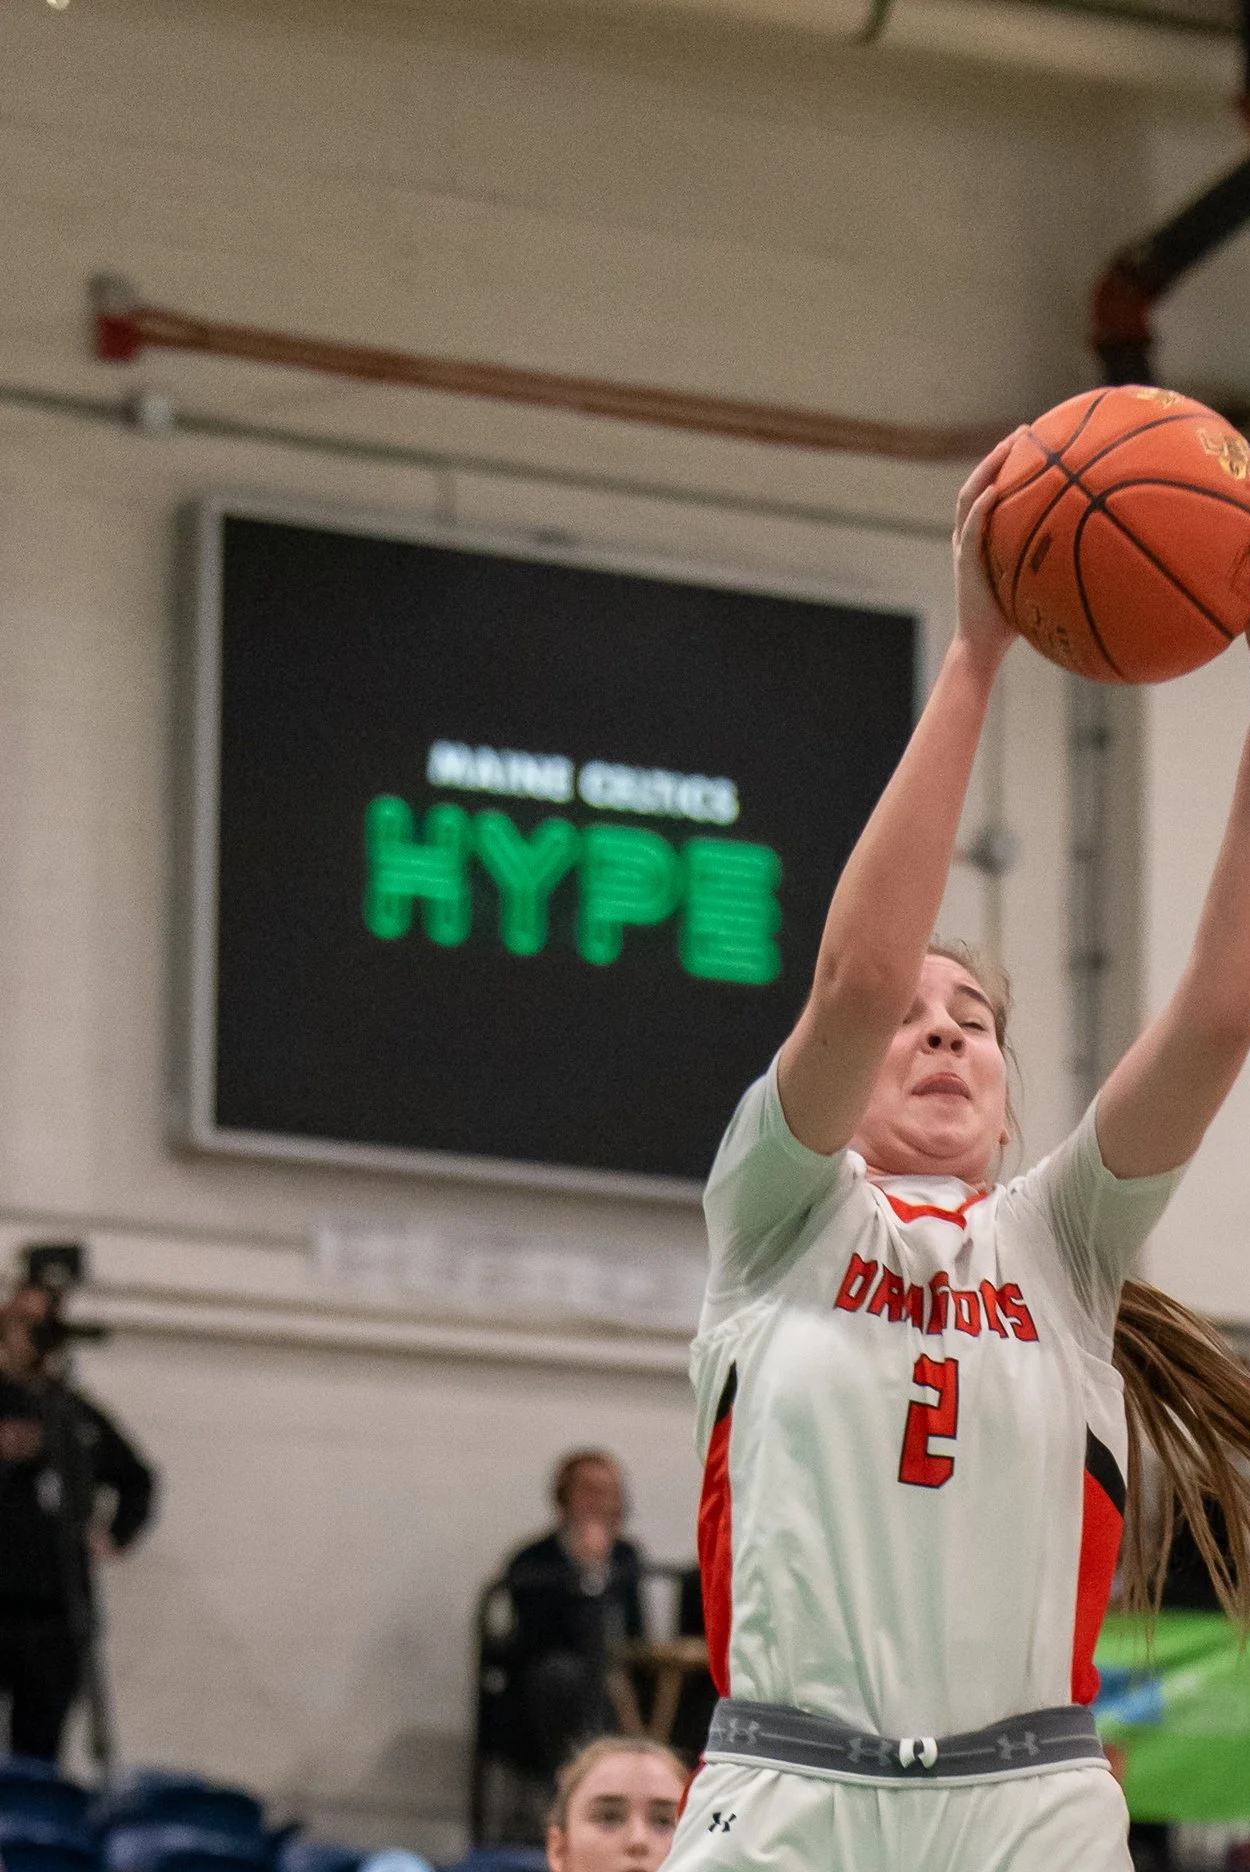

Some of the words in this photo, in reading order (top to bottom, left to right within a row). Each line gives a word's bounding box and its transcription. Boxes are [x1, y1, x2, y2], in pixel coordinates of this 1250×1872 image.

[427, 740, 575, 803] MAINE
[578, 760, 741, 826] CELTICS
[363, 793, 784, 986] HYPE
[897, 1353, 959, 1489] 2
